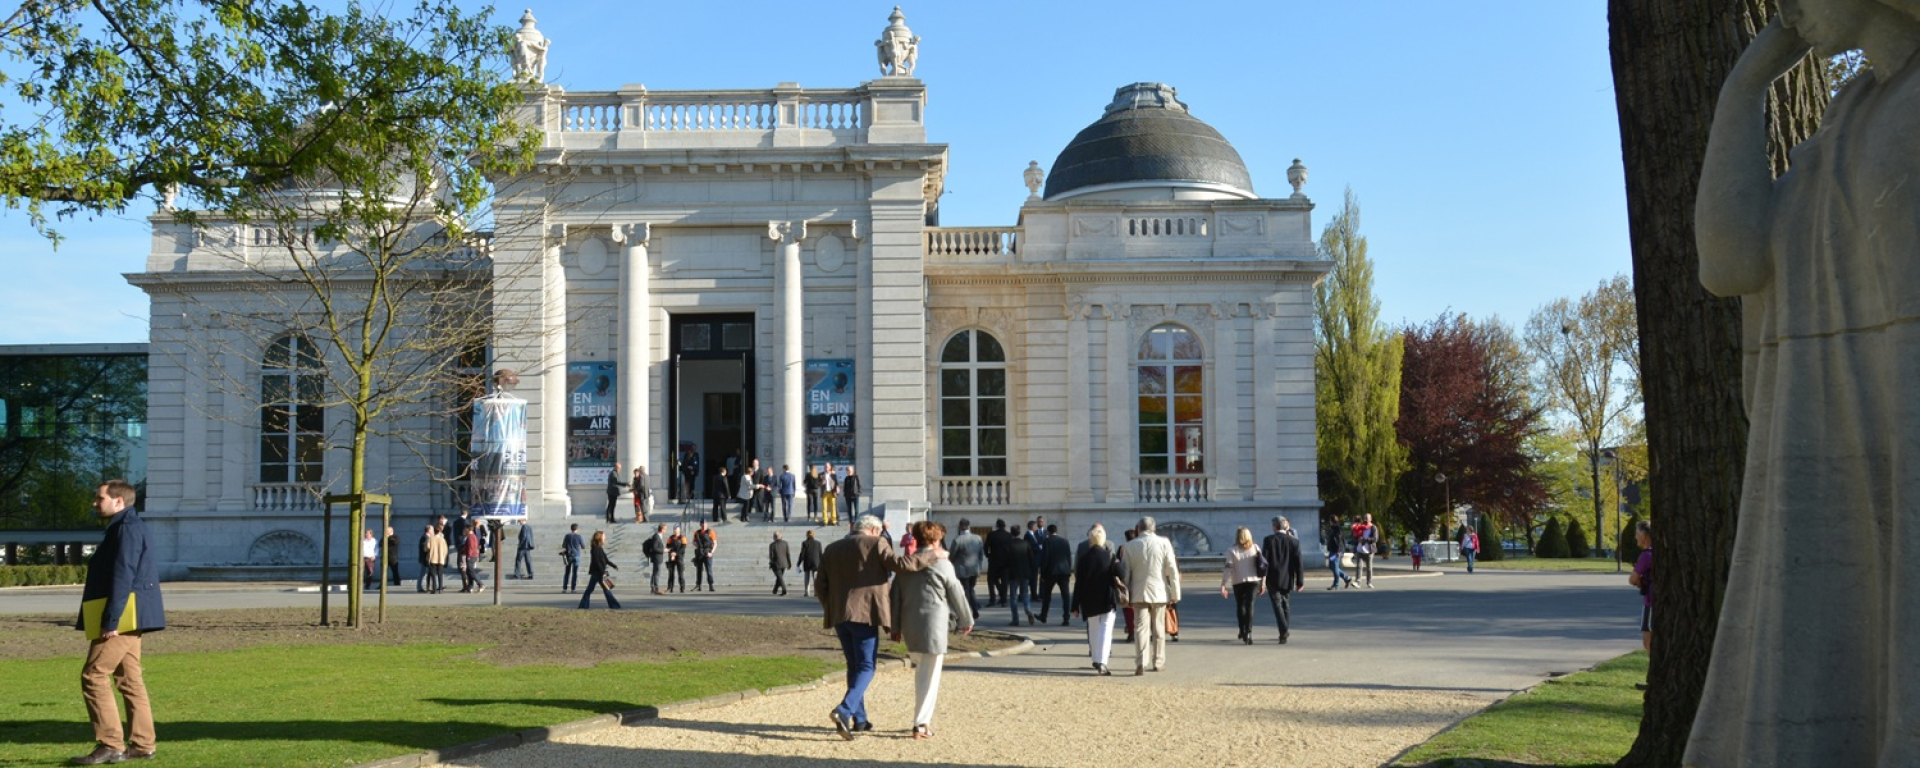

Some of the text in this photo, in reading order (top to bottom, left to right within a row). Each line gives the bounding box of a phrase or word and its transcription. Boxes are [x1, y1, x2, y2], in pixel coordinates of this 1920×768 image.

[573, 392, 592, 404] EN
[811, 389, 830, 402] EN
[573, 405, 612, 417] PLEIN
[811, 402, 850, 415] PLEIN
[590, 418, 611, 430] AIR
[828, 415, 850, 426] AIR
